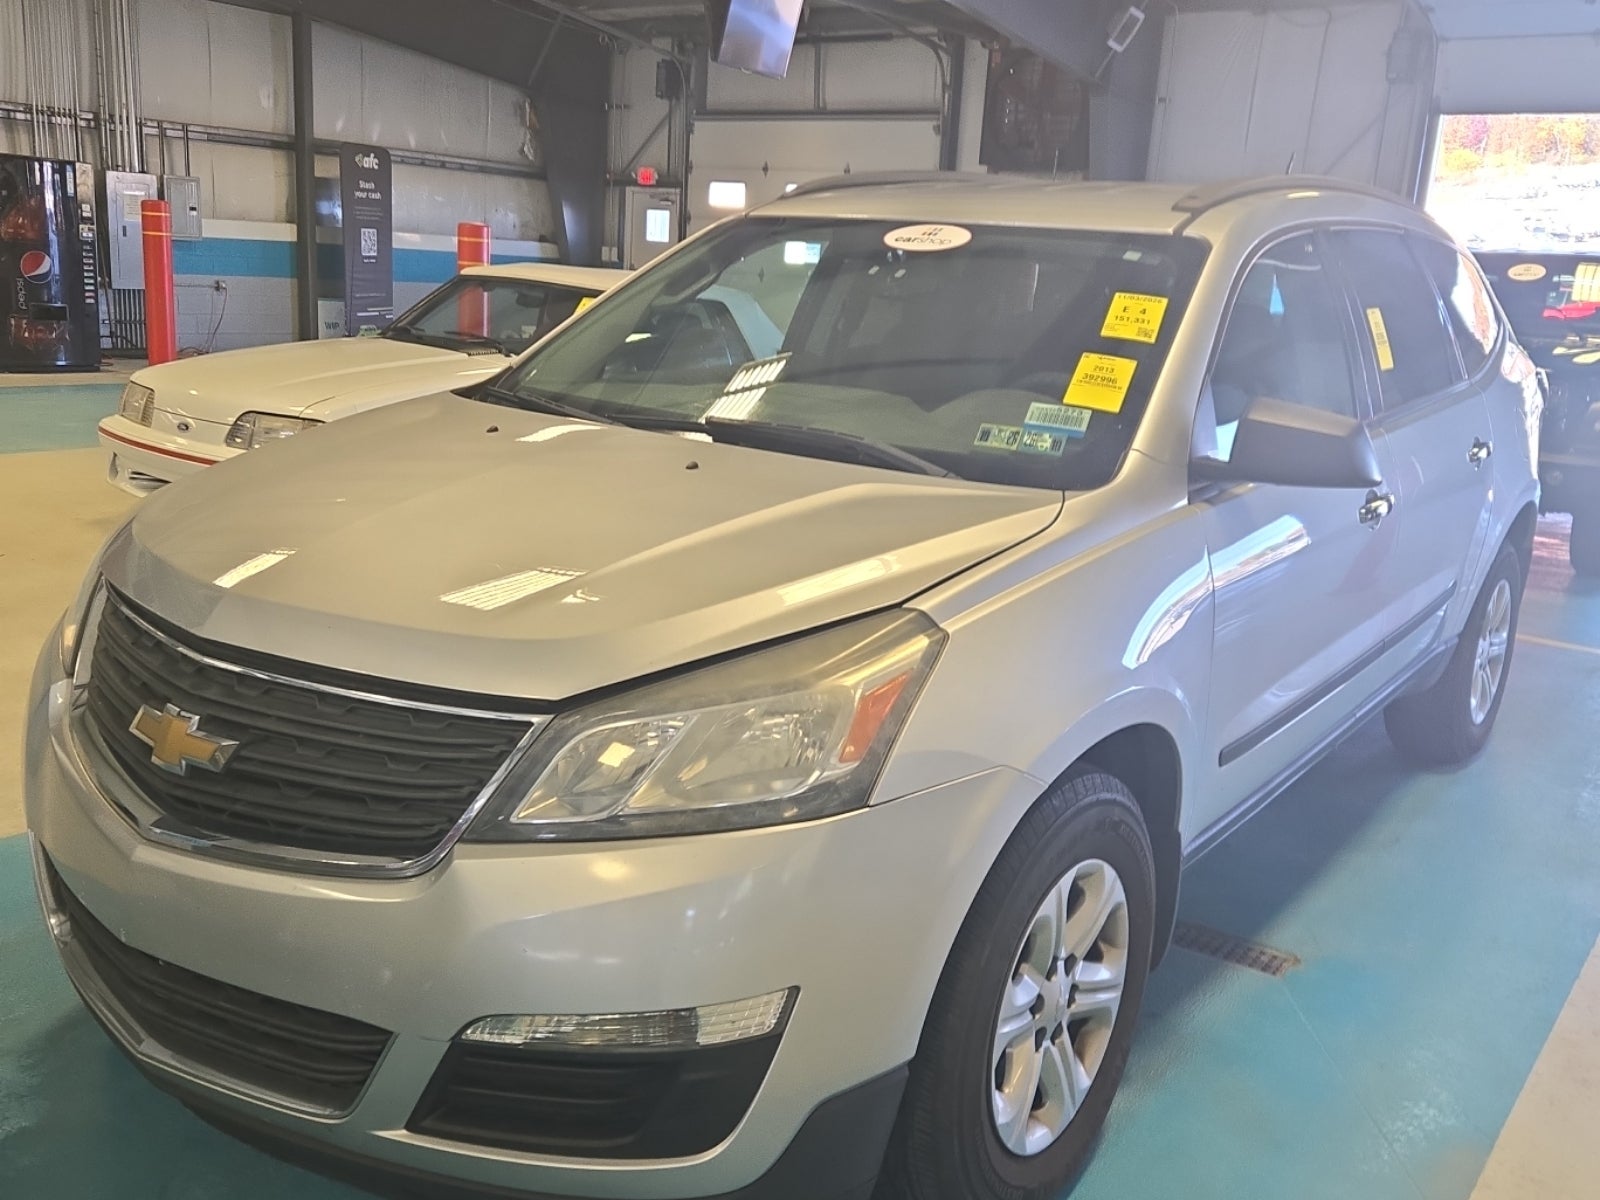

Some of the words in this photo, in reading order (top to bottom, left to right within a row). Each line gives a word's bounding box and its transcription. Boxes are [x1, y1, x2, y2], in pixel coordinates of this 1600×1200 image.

[354, 190, 367, 199] your
[367, 191, 382, 200] cash
[15, 277, 28, 310] pepsi
[1114, 315, 1151, 325] 151,331
[1092, 364, 1116, 374] 2013
[1081, 372, 1118, 385] 392996
